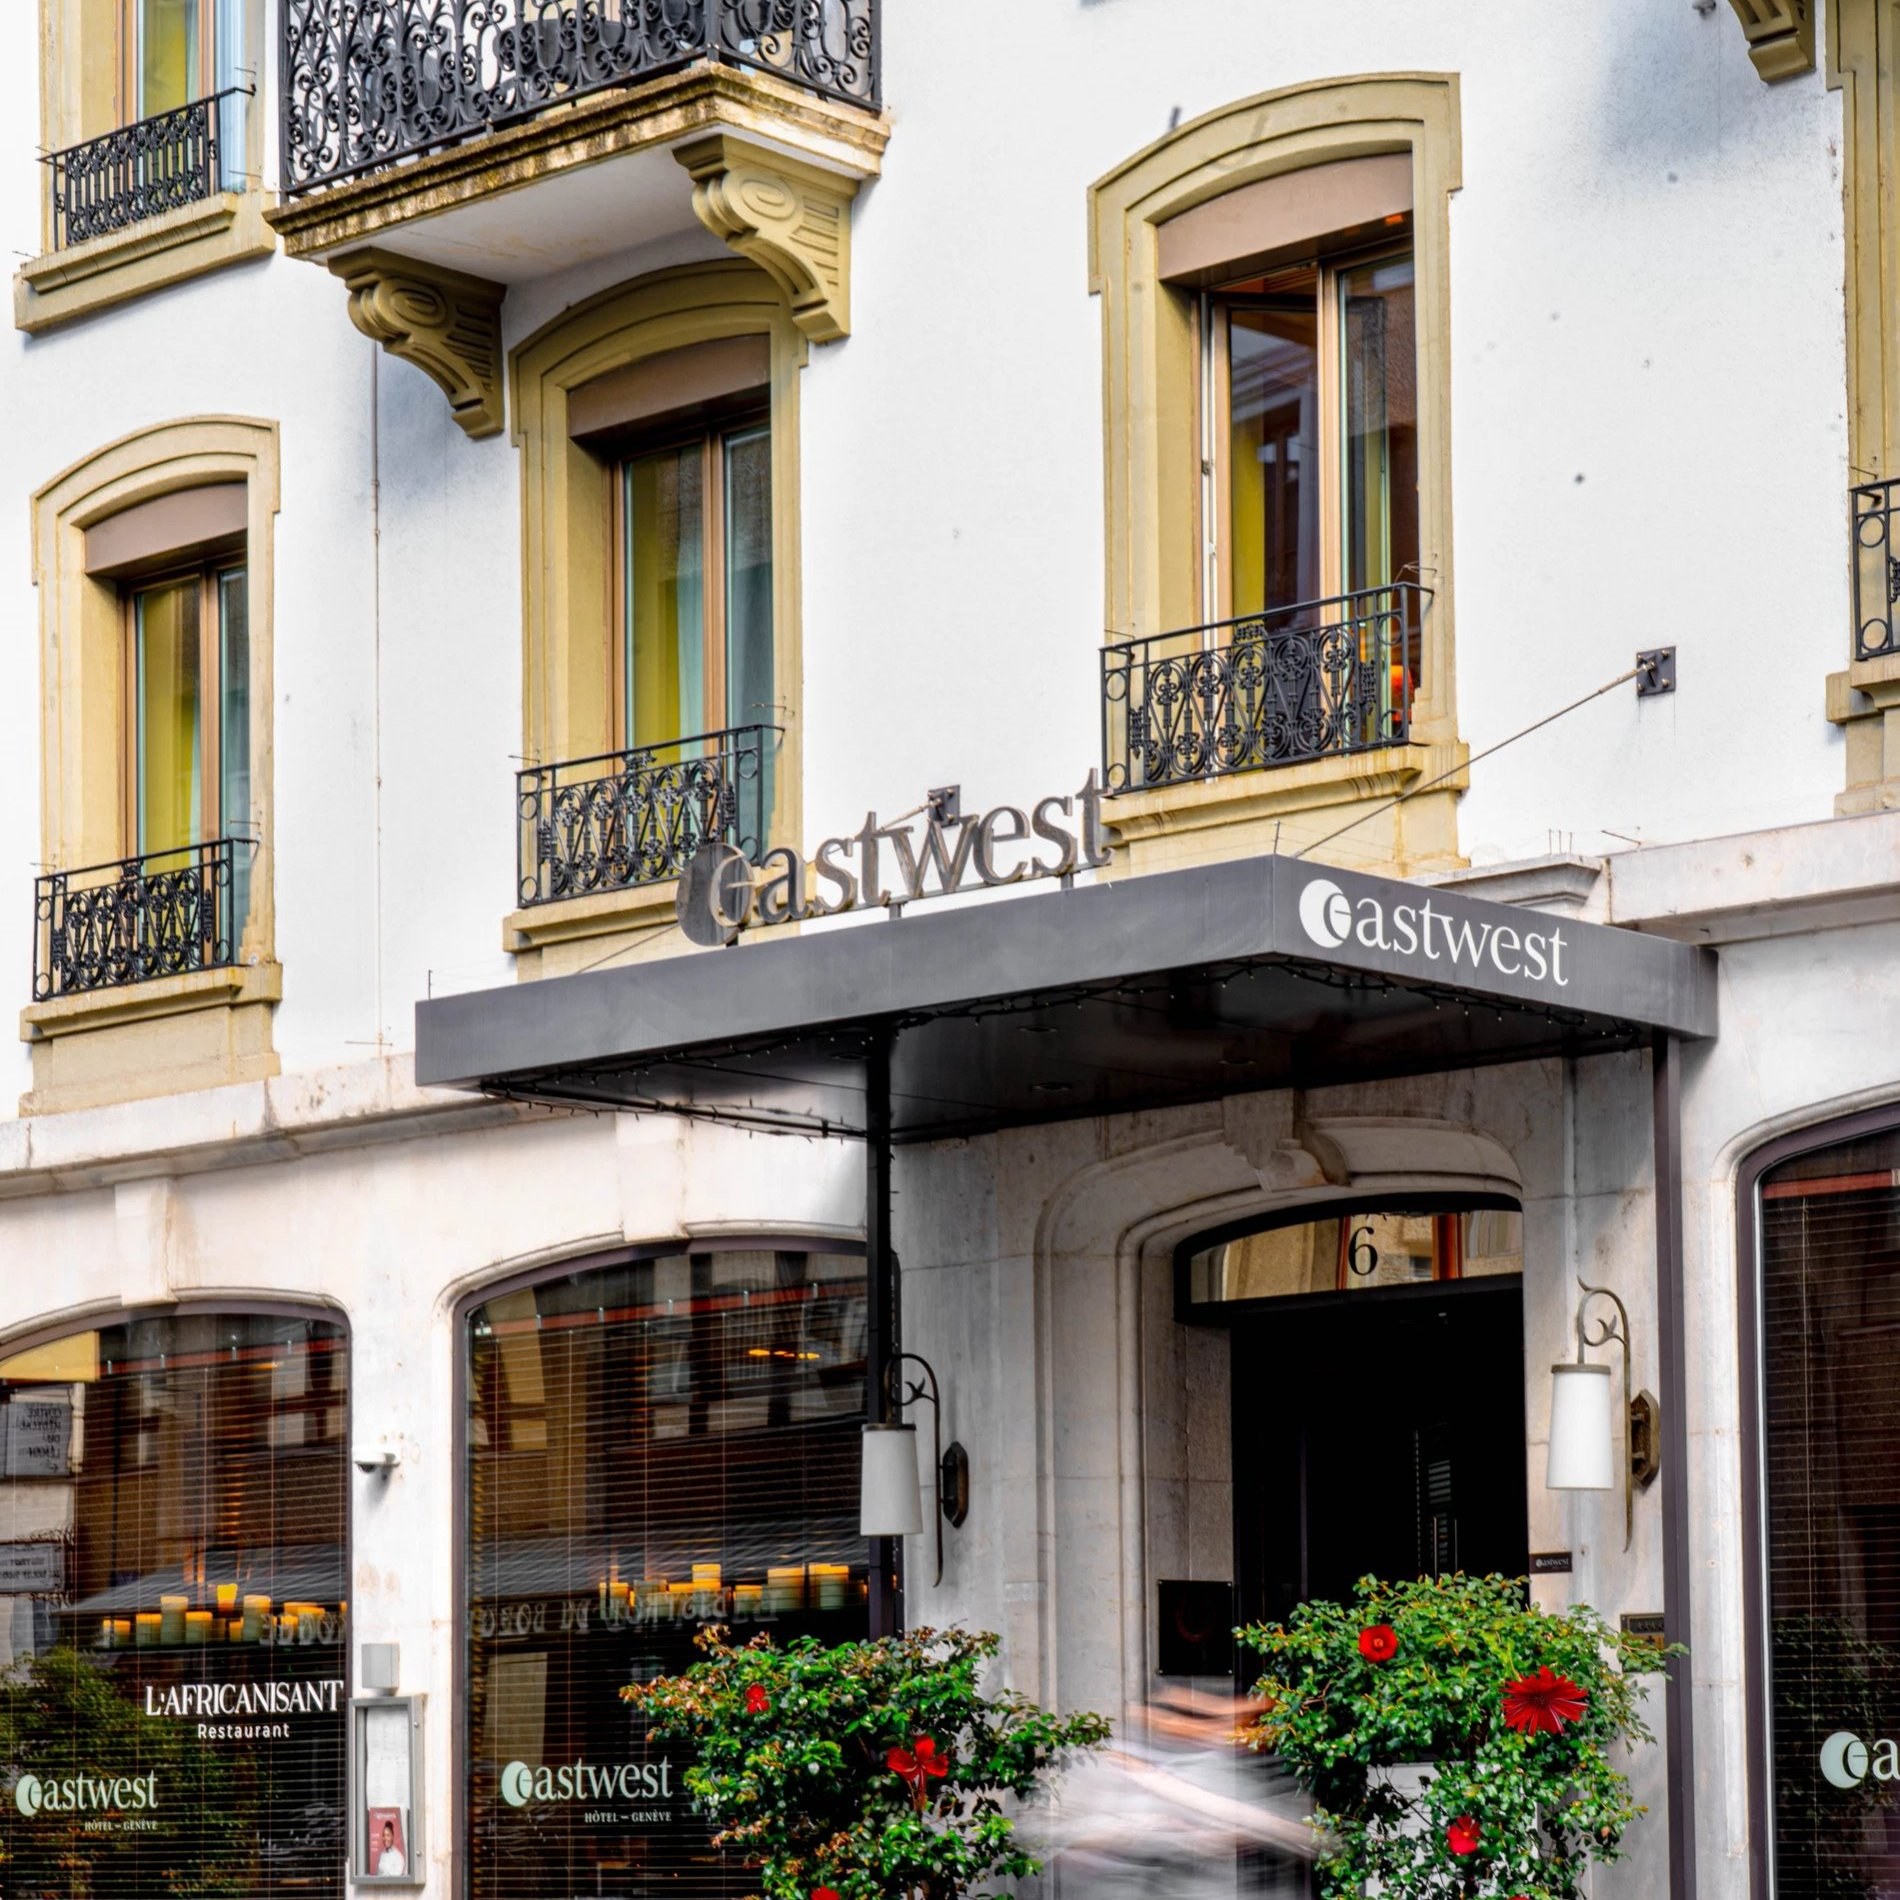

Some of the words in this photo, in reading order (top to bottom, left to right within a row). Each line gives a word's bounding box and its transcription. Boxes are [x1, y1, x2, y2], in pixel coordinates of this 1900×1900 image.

[677, 768, 1112, 946] eastwest
[1299, 878, 1569, 986] eastwest
[1348, 1226, 1378, 1276] 6
[145, 1680, 344, 1716] L'AFRICANISANT
[198, 1723, 290, 1739] Restaurant
[15, 1769, 159, 1817] eastwest
[501, 1755, 673, 1807] eastwest
[123, 1819, 158, 1831] GENÈVE
[631, 1809, 672, 1822] GENÈVE
